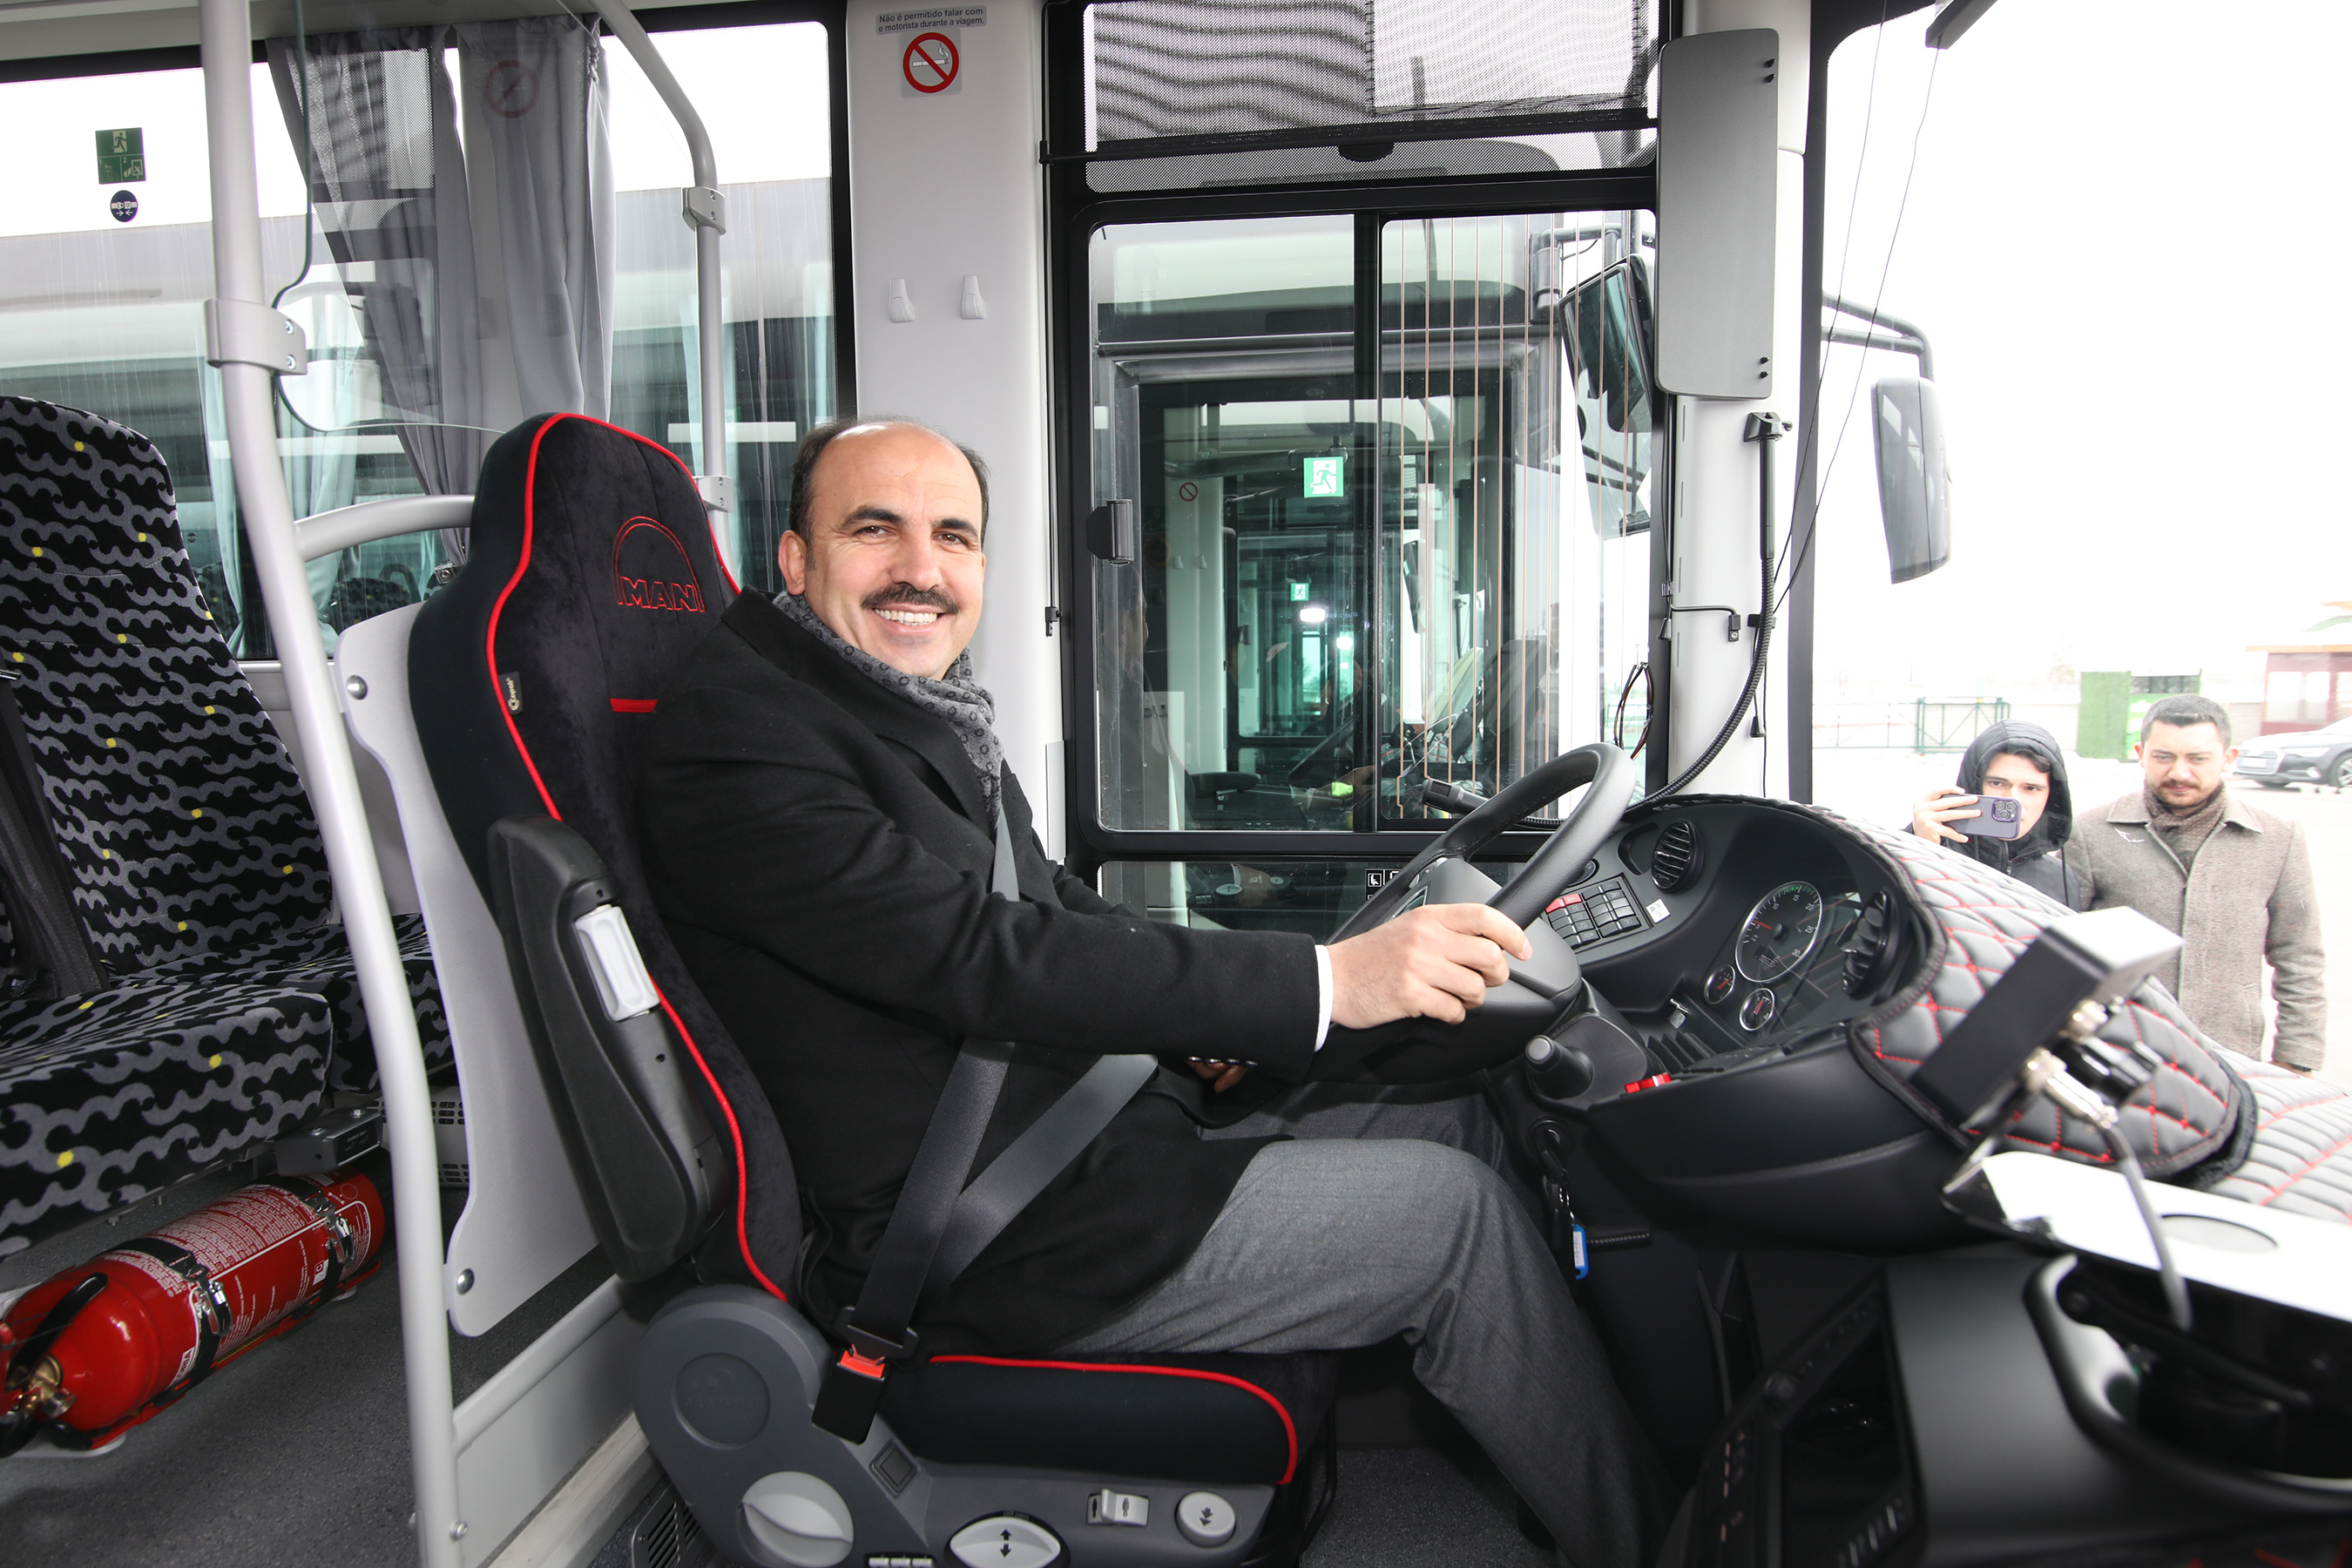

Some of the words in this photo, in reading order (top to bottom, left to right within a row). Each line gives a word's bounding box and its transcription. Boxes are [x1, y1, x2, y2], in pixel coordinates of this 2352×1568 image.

[879, 15, 896, 24] Não
[896, 13, 902, 22] é
[904, 10, 943, 22] permitido
[884, 21, 919, 31] motorista
[920, 19, 948, 28] durante
[956, 17, 985, 27] viagem.
[619, 576, 699, 612] MAN
